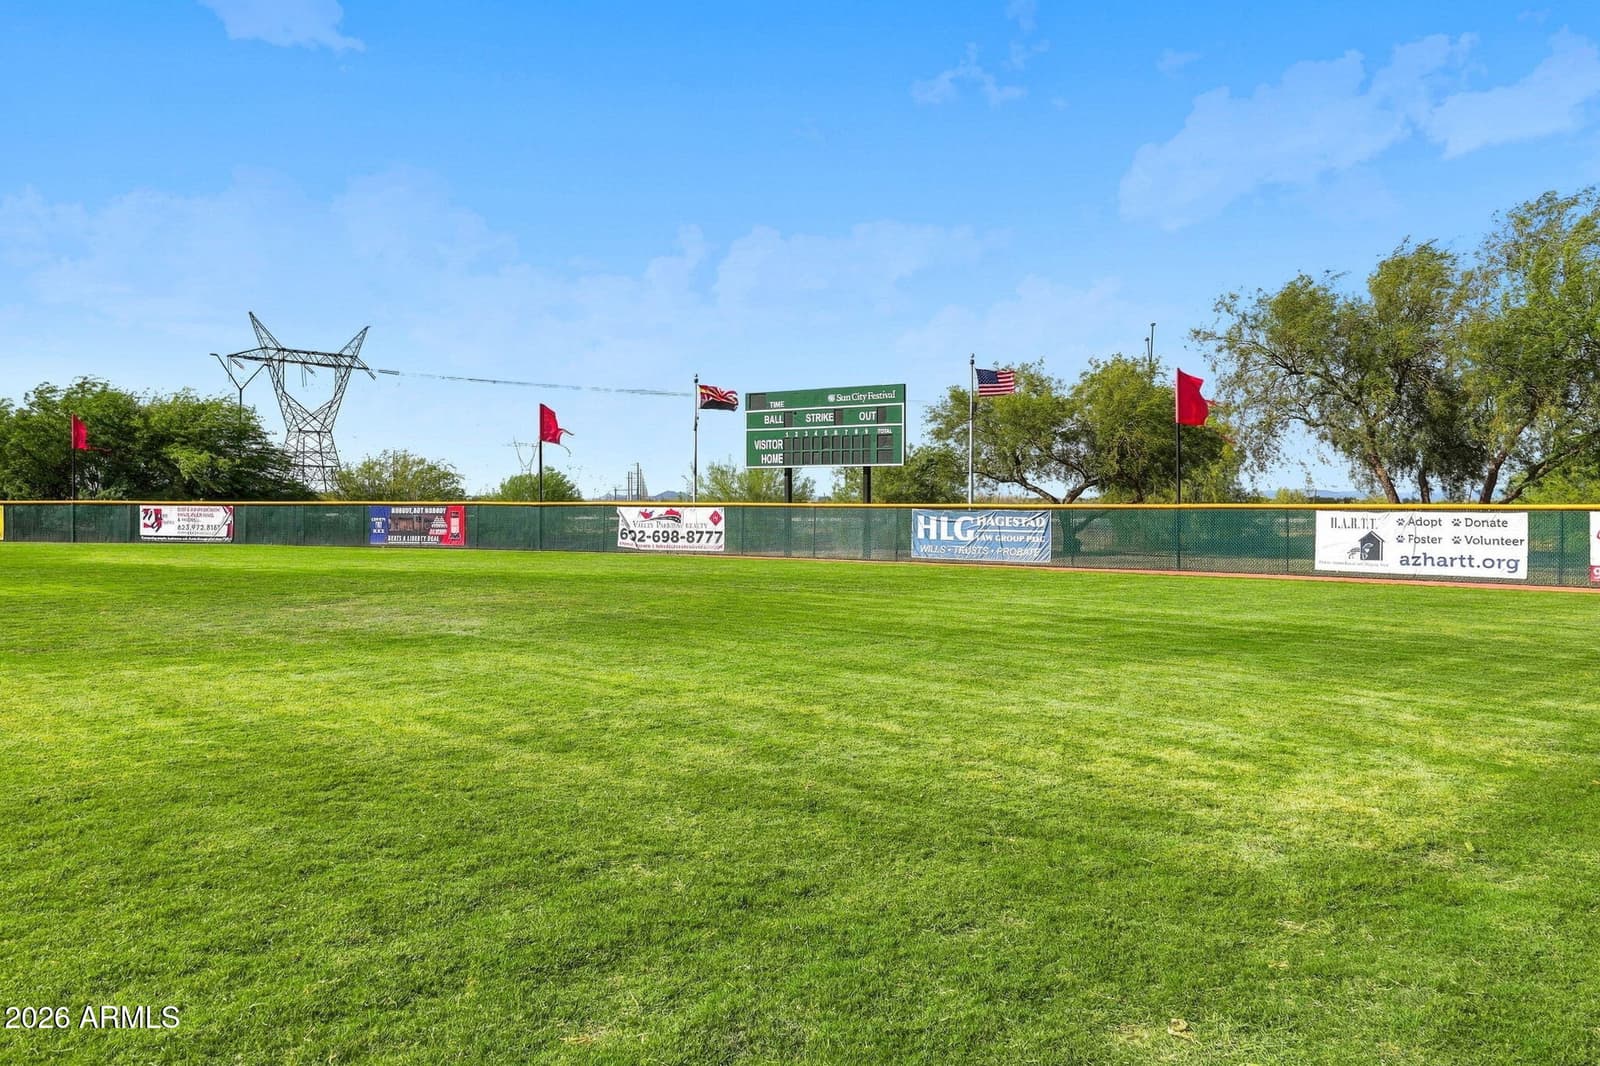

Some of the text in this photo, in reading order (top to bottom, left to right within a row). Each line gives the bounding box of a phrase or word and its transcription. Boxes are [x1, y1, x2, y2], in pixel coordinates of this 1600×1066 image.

[836, 390, 896, 402] Sun City Festival
[769, 400, 785, 409] TIME
[764, 411, 876, 424] BALL STRIKE OUT
[754, 439, 784, 450] VISITOR
[761, 453, 784, 464] HOME
[916, 514, 975, 542] HLG
[976, 516, 1045, 528] HAGESTAD
[1407, 516, 1509, 530] Adopt Donate
[619, 527, 723, 544] 602-698-8777
[995, 534, 1026, 543] GROUP
[1407, 533, 1525, 547] Foster Volunteer
[920, 544, 1041, 557] WILLS TRUSTS PROBATE
[1399, 553, 1521, 573] azhartt.org
